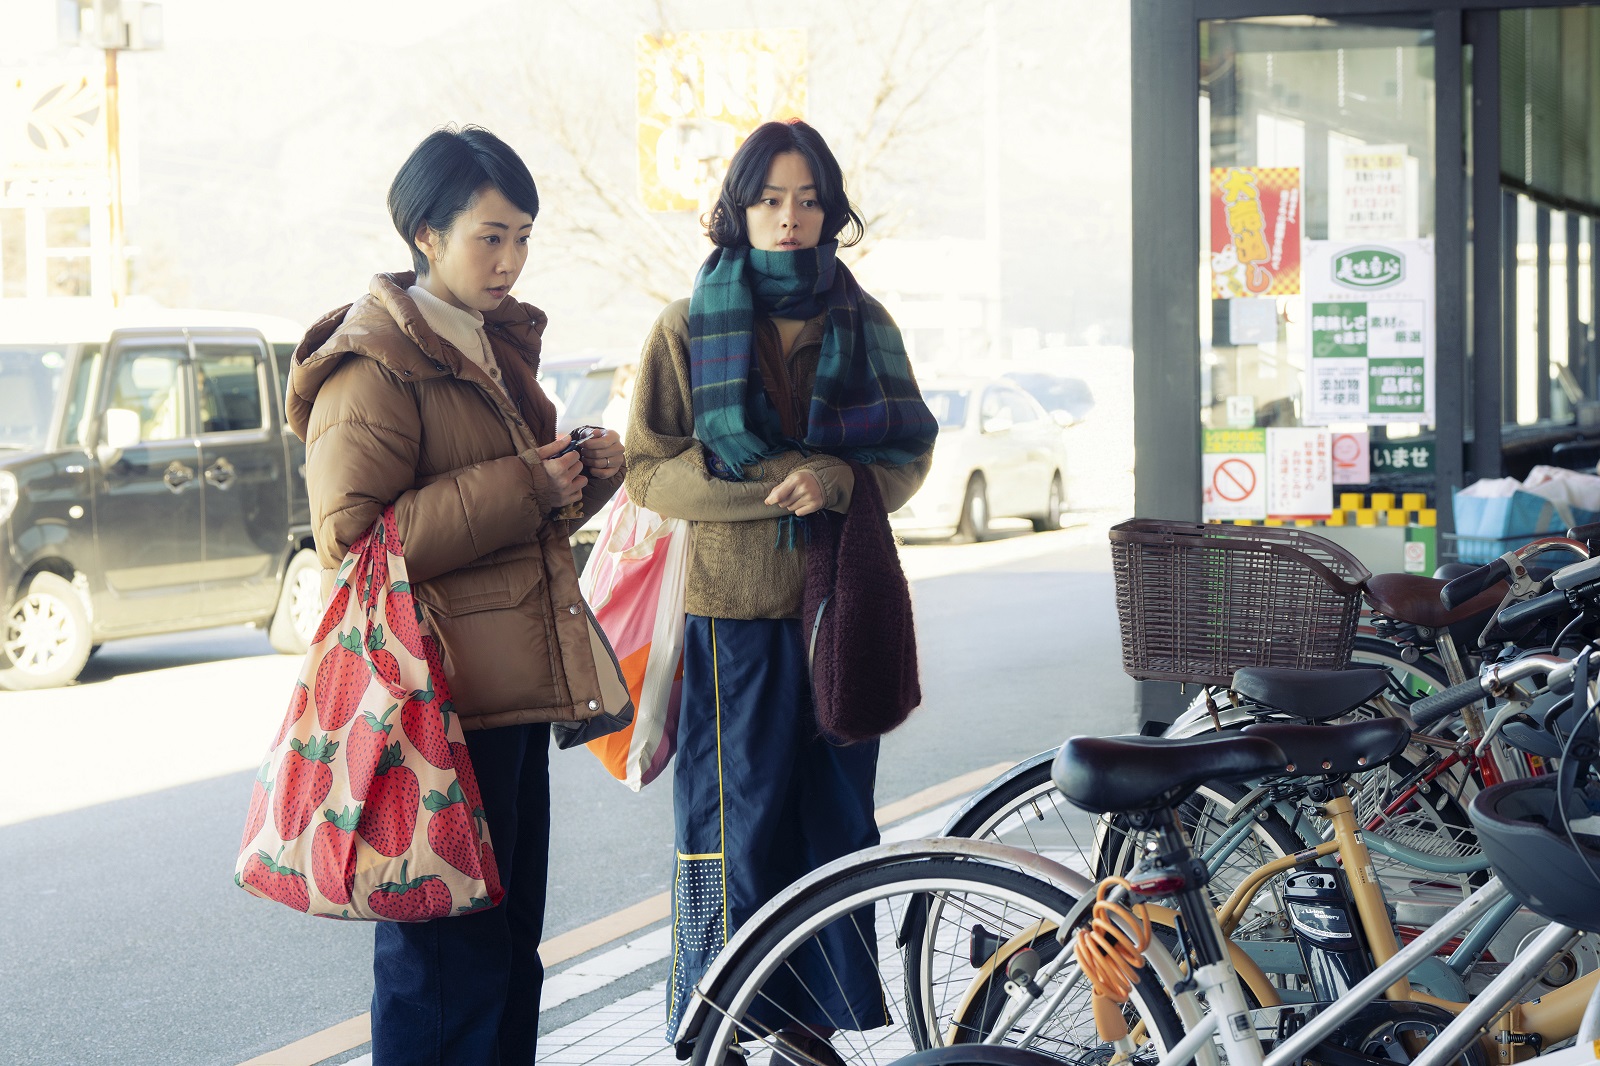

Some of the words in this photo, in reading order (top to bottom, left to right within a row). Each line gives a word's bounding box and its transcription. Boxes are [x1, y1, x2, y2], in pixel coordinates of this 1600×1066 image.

[1312, 315, 1367, 331] 美味しさ
[1320, 379, 1360, 391] 添加物
[1320, 393, 1360, 405] 不使用
